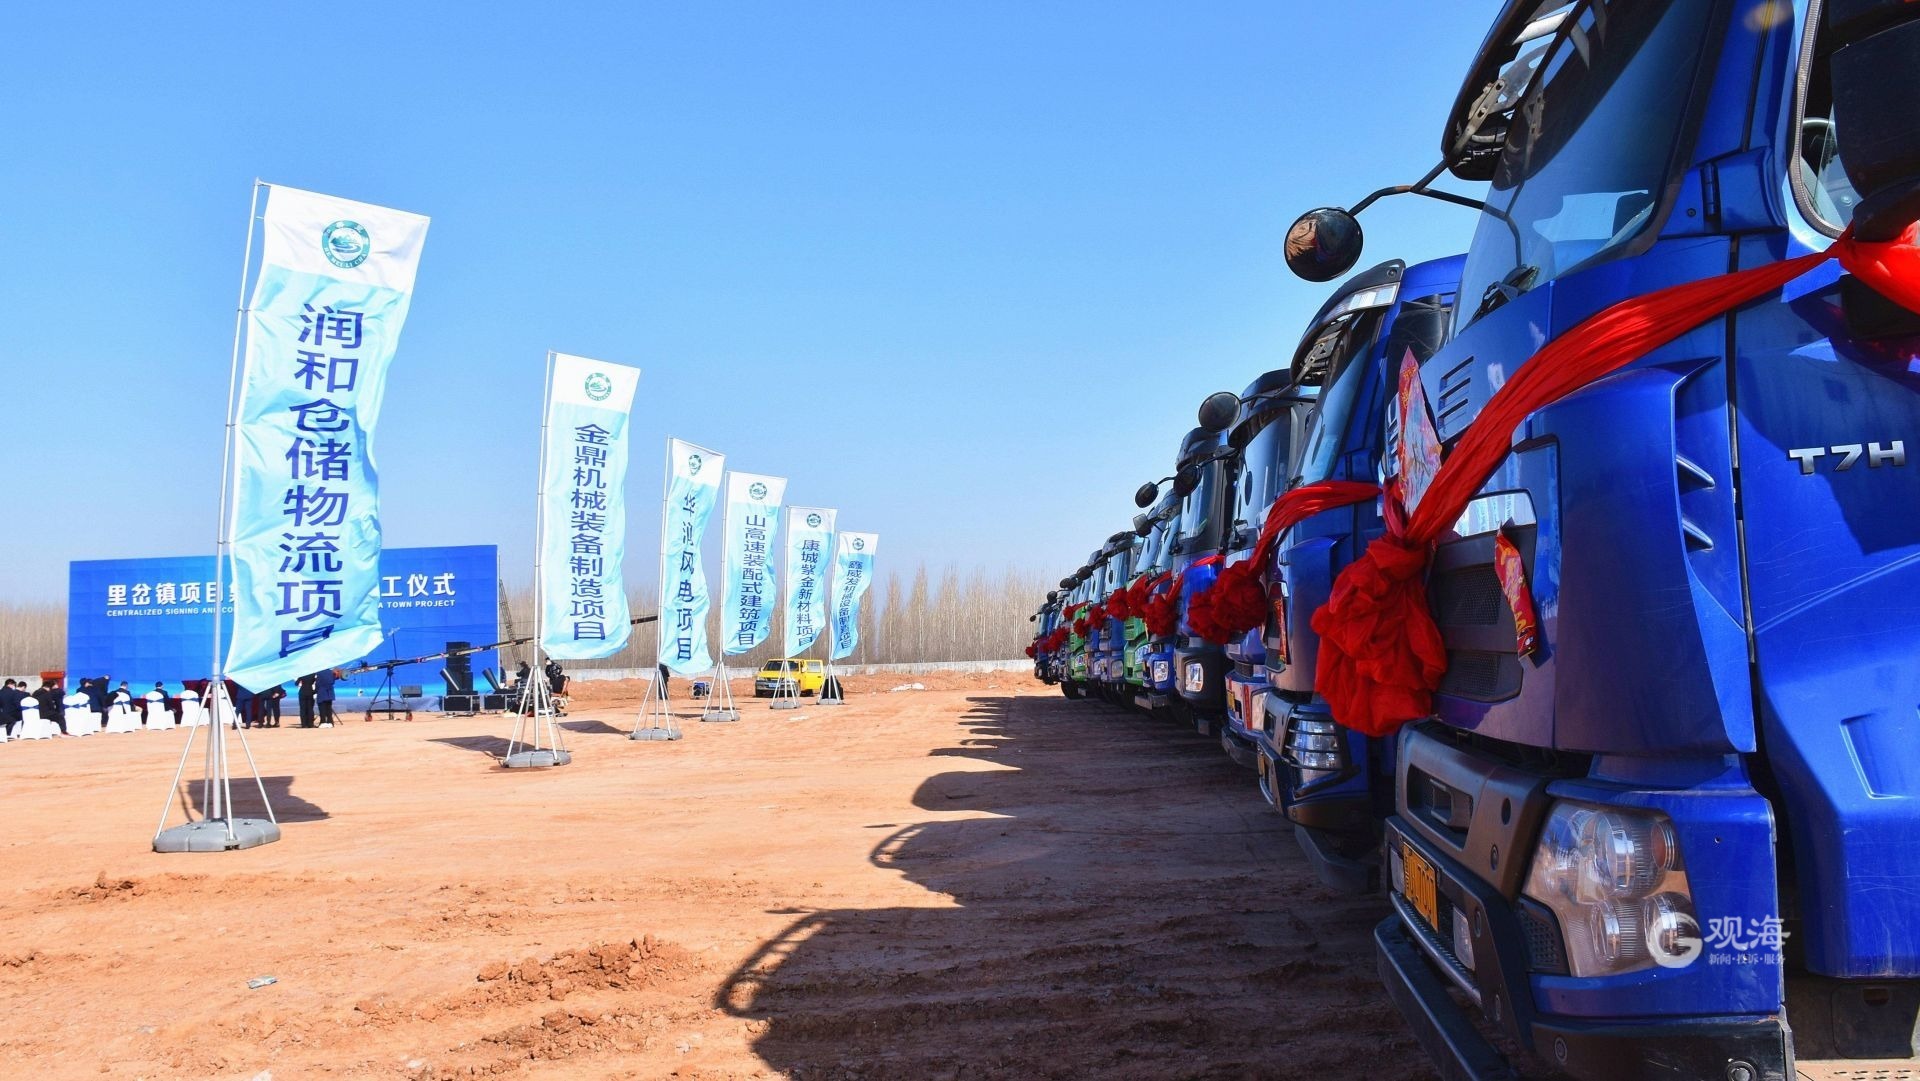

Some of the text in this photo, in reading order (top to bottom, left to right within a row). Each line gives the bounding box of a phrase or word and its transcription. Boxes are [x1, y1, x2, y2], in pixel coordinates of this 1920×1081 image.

[275, 303, 364, 658] 润和仓储物流项目
[1788, 440, 1906, 475] T7H
[381, 573, 456, 597] 工仪式
[569, 423, 611, 641] 金鼎机械装备制造项目
[737, 514, 767, 645] 山高速装配式建筑项目
[106, 608, 163, 617] CENTRALIZED
[165, 607, 199, 615] SIGNING
[201, 606, 218, 614] AN
[796, 539, 820, 647] 康城紫金新材料项目
